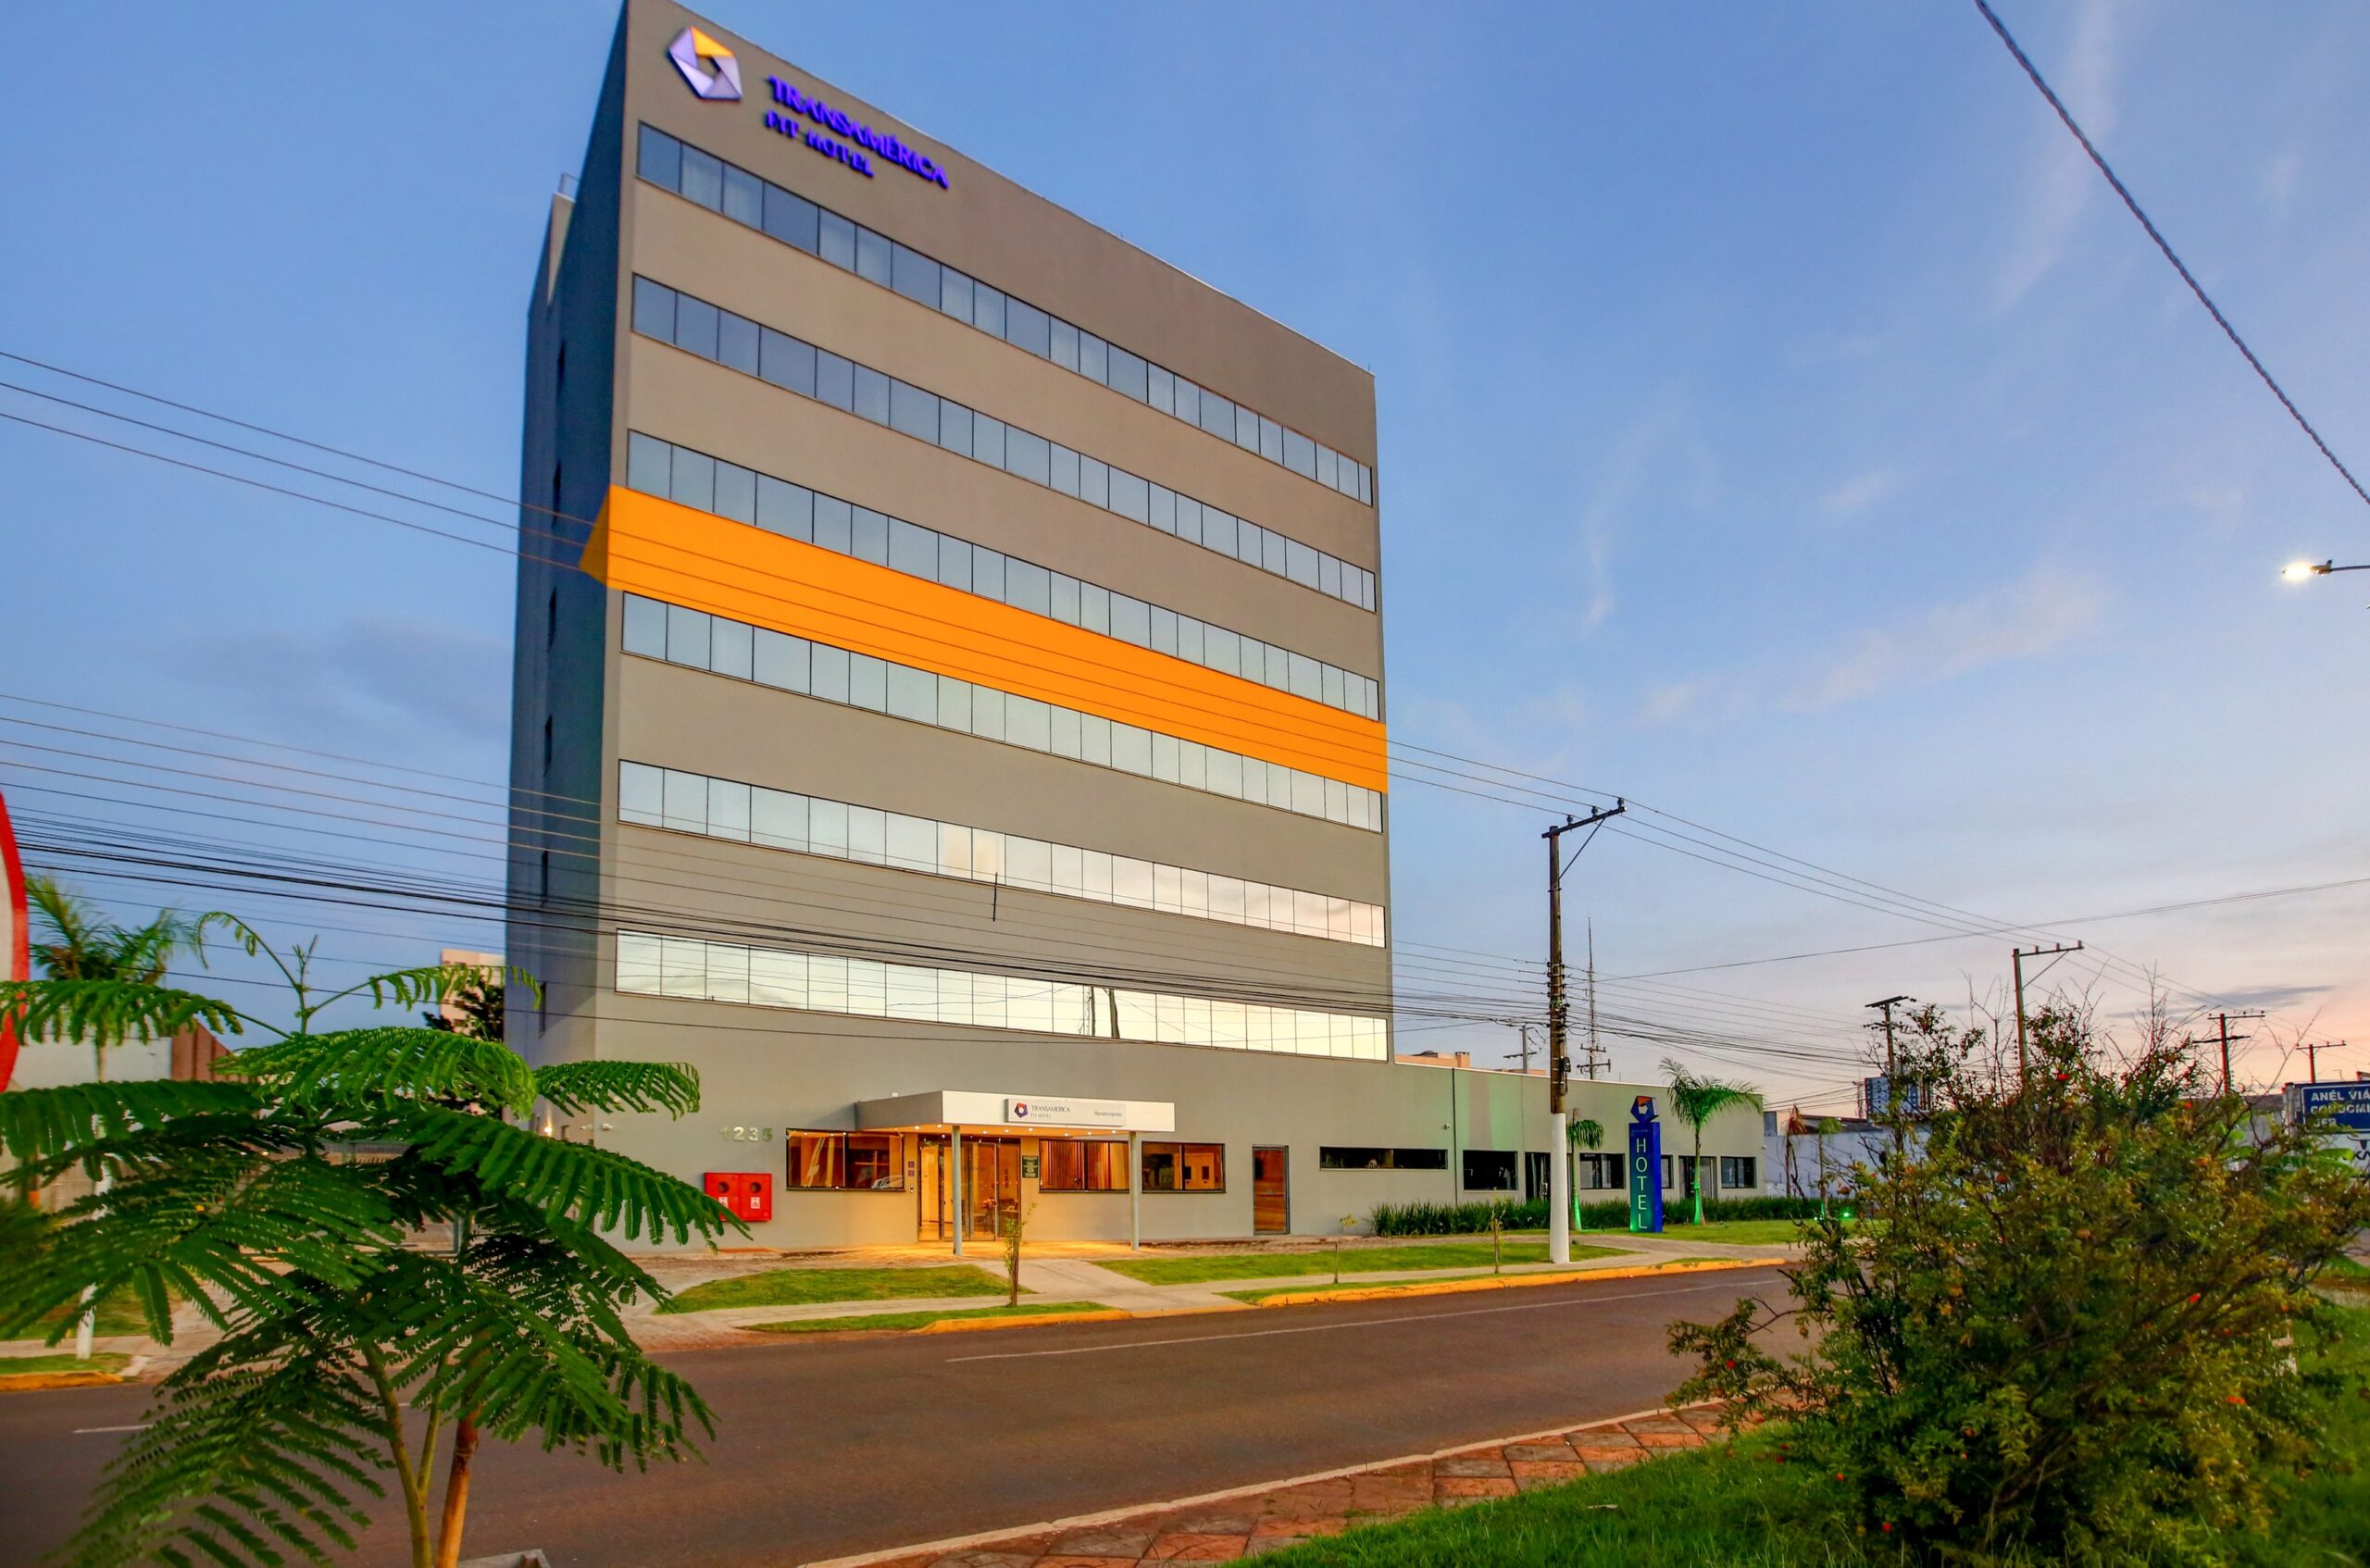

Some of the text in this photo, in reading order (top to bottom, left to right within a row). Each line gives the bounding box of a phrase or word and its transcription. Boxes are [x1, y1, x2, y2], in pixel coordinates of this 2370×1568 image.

[765, 108, 875, 179] FIT HOTEL
[767, 74, 949, 191] TRANSAMÉRICA
[1636, 1138, 1648, 1229] HOTEL
